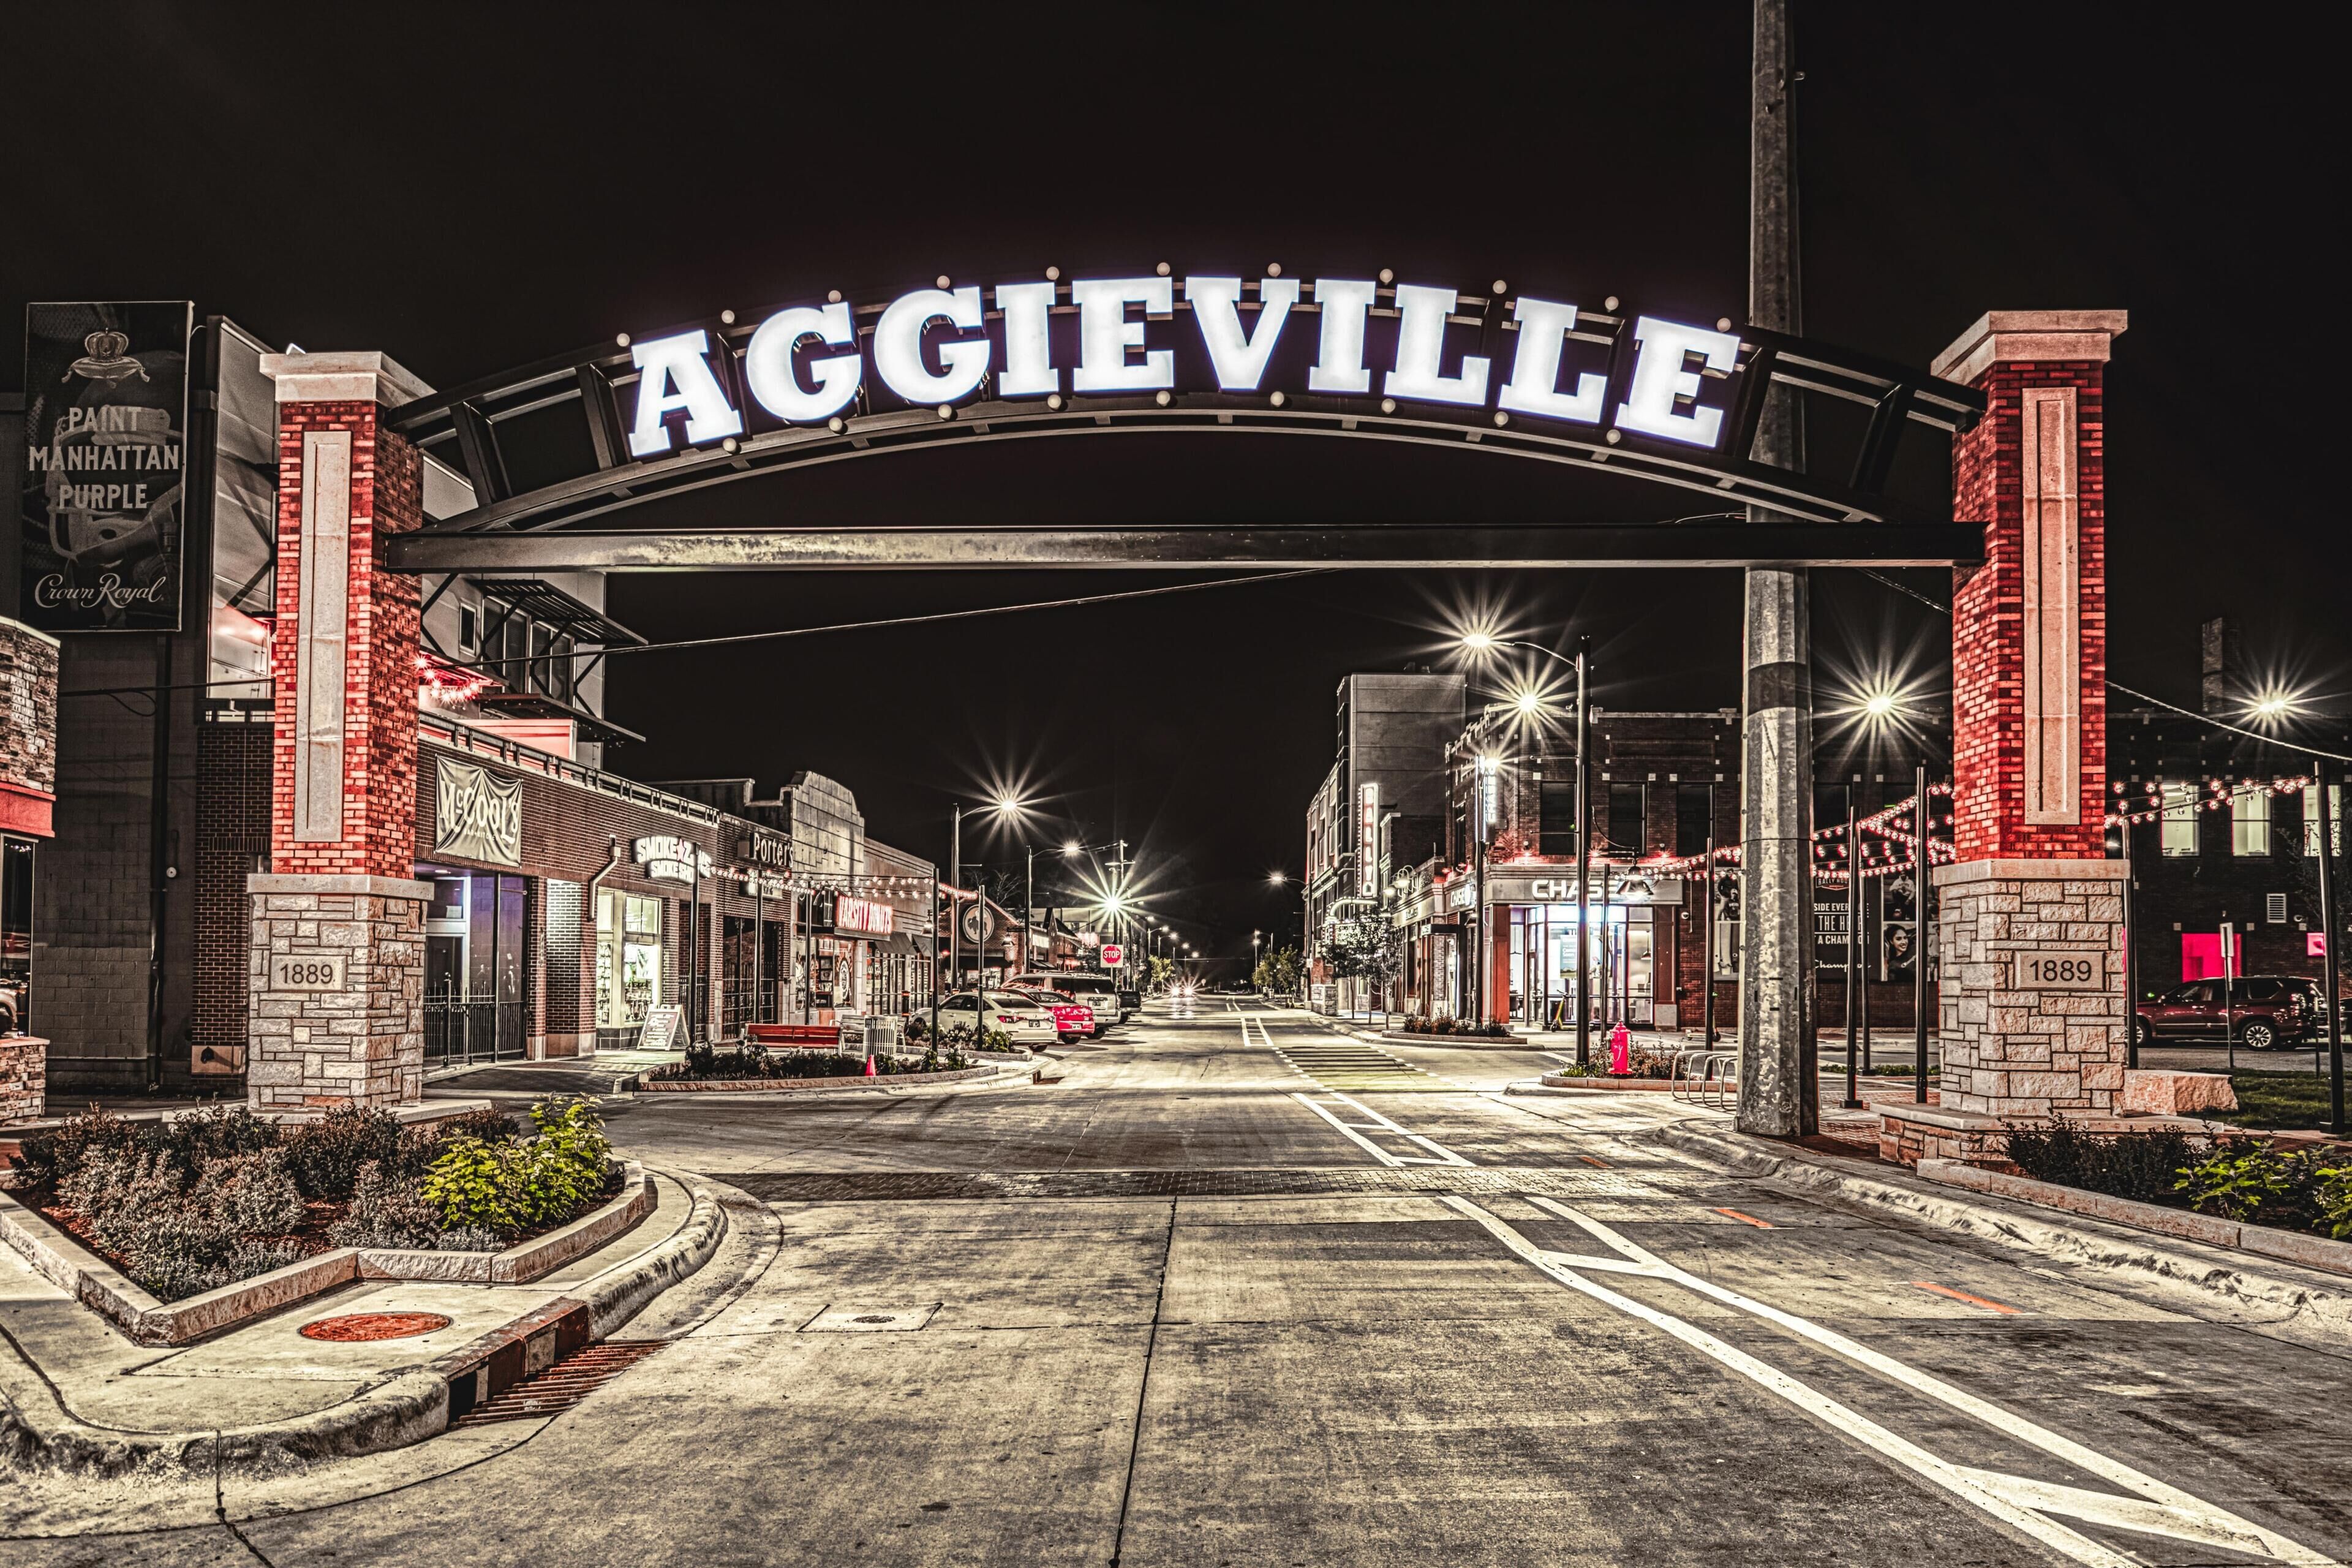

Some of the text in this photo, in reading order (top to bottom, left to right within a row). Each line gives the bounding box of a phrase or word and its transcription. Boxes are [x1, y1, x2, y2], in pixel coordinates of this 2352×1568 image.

[628, 276, 1741, 457] AGGIEVILLE
[69, 407, 141, 432] PAINT
[29, 445, 179, 471] MANHATTAN
[59, 483, 148, 509] PURPLE
[35, 573, 164, 608] Crown Royal
[636, 835, 678, 863] SMOKE
[753, 832, 794, 868] Porter's
[650, 860, 695, 884] SMOKE SHO
[1450, 886, 1466, 907] CHASE
[1532, 880, 1621, 899] CHASE
[839, 895, 893, 934] VARSITY DONUTS
[1814, 903, 1830, 911] SIDE
[1819, 915, 1836, 931] THE
[1818, 935, 1824, 944] A
[280, 963, 333, 984] 1889
[2029, 960, 2092, 981] 1889
